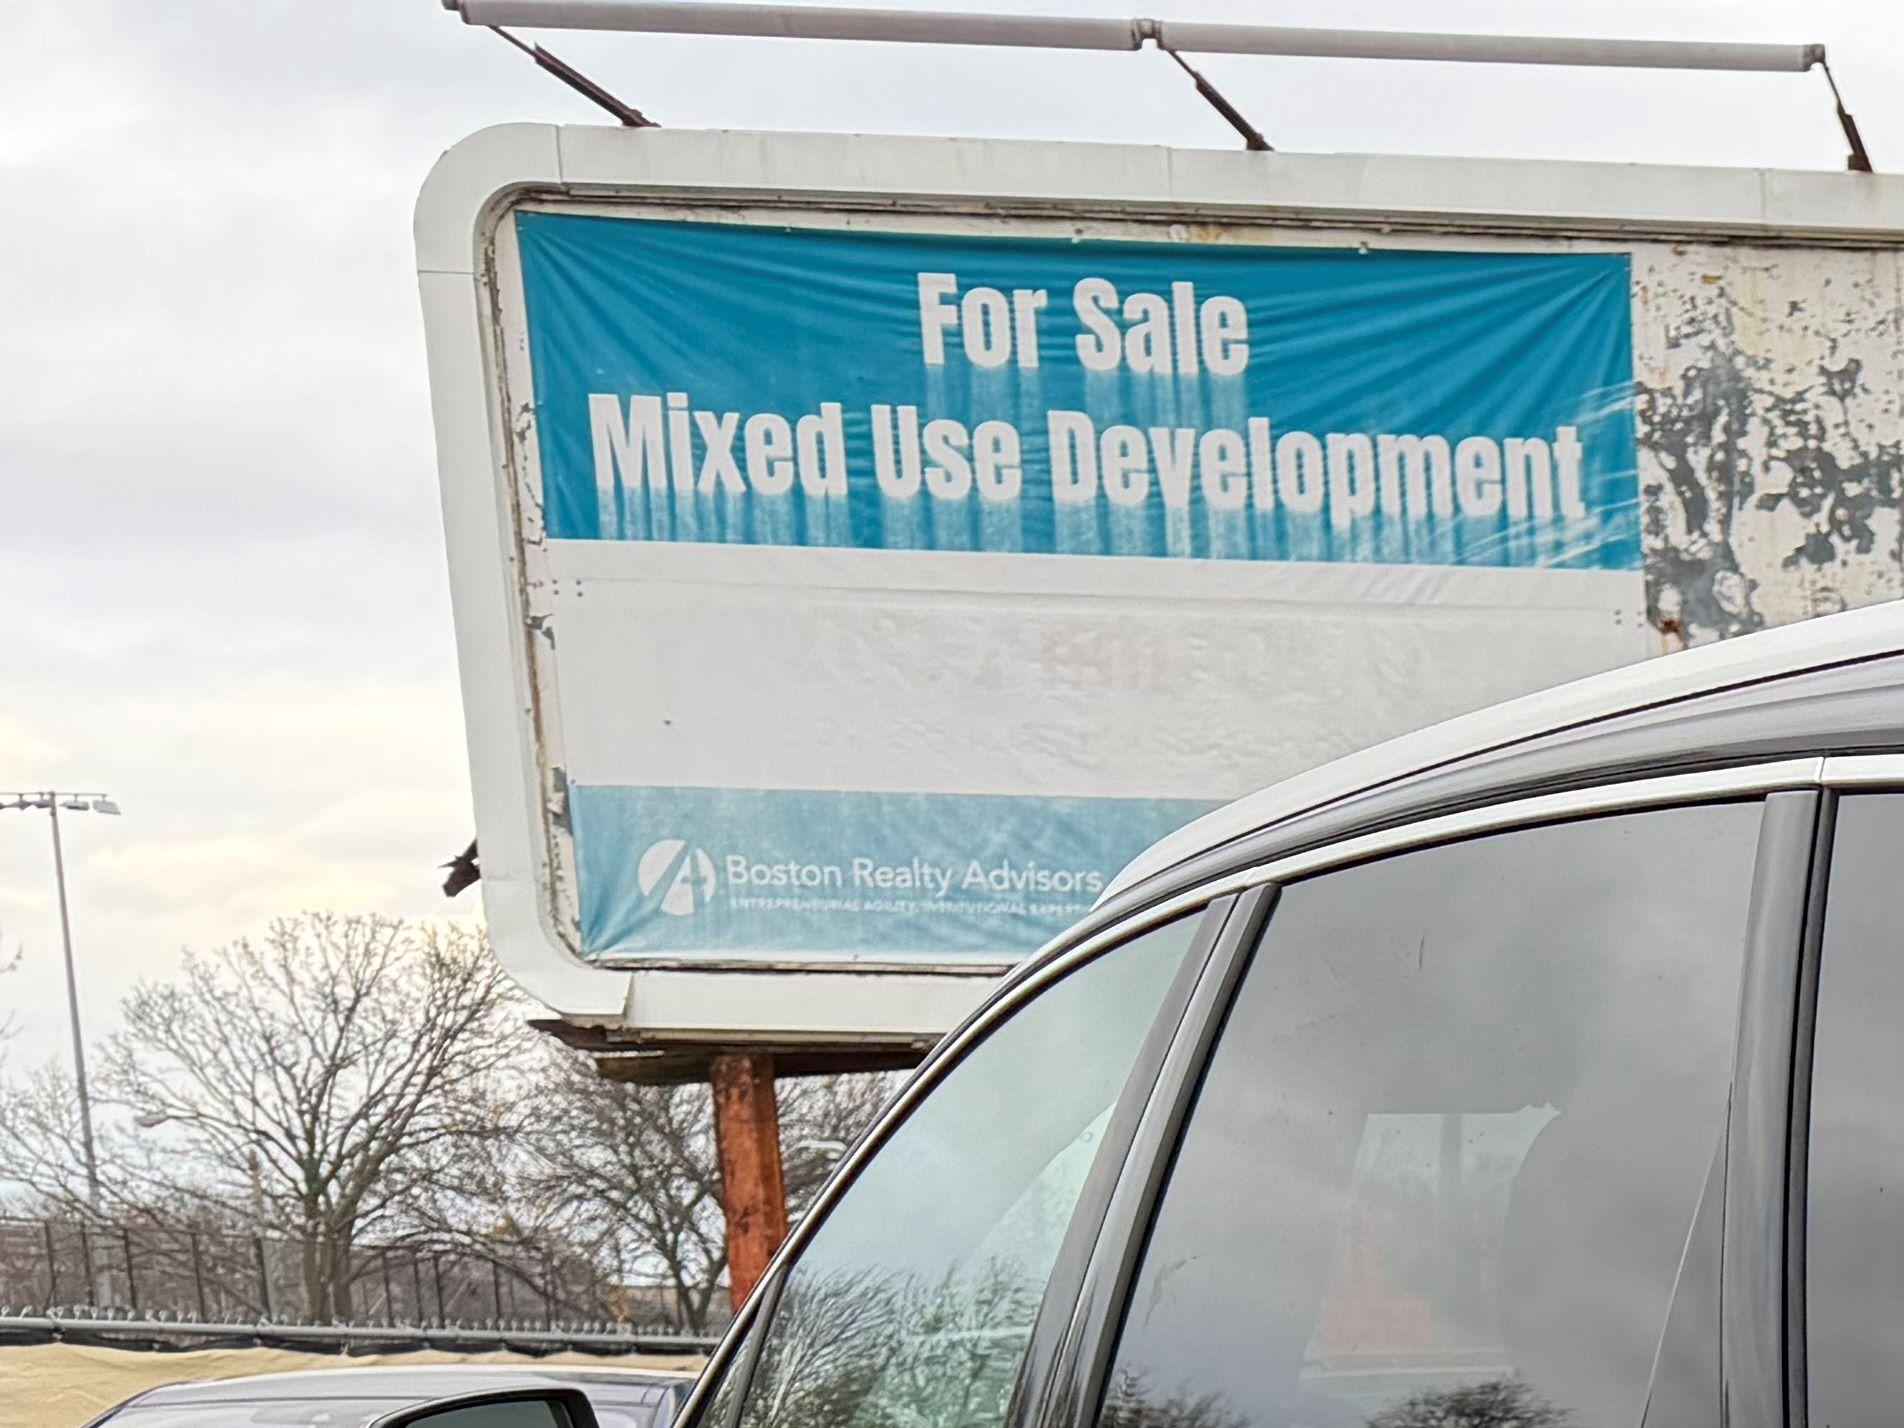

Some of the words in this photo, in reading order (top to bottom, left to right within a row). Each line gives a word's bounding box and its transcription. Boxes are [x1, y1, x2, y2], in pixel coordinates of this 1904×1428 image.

[917, 272, 1048, 370] For
[1073, 276, 1249, 375] Sale
[589, 393, 848, 496] Mixed
[872, 404, 1022, 501] Use
[1050, 410, 1585, 530] Development
[725, 855, 843, 886] Boston
[853, 857, 953, 897] Realty
[961, 859, 1103, 893] Advisors
